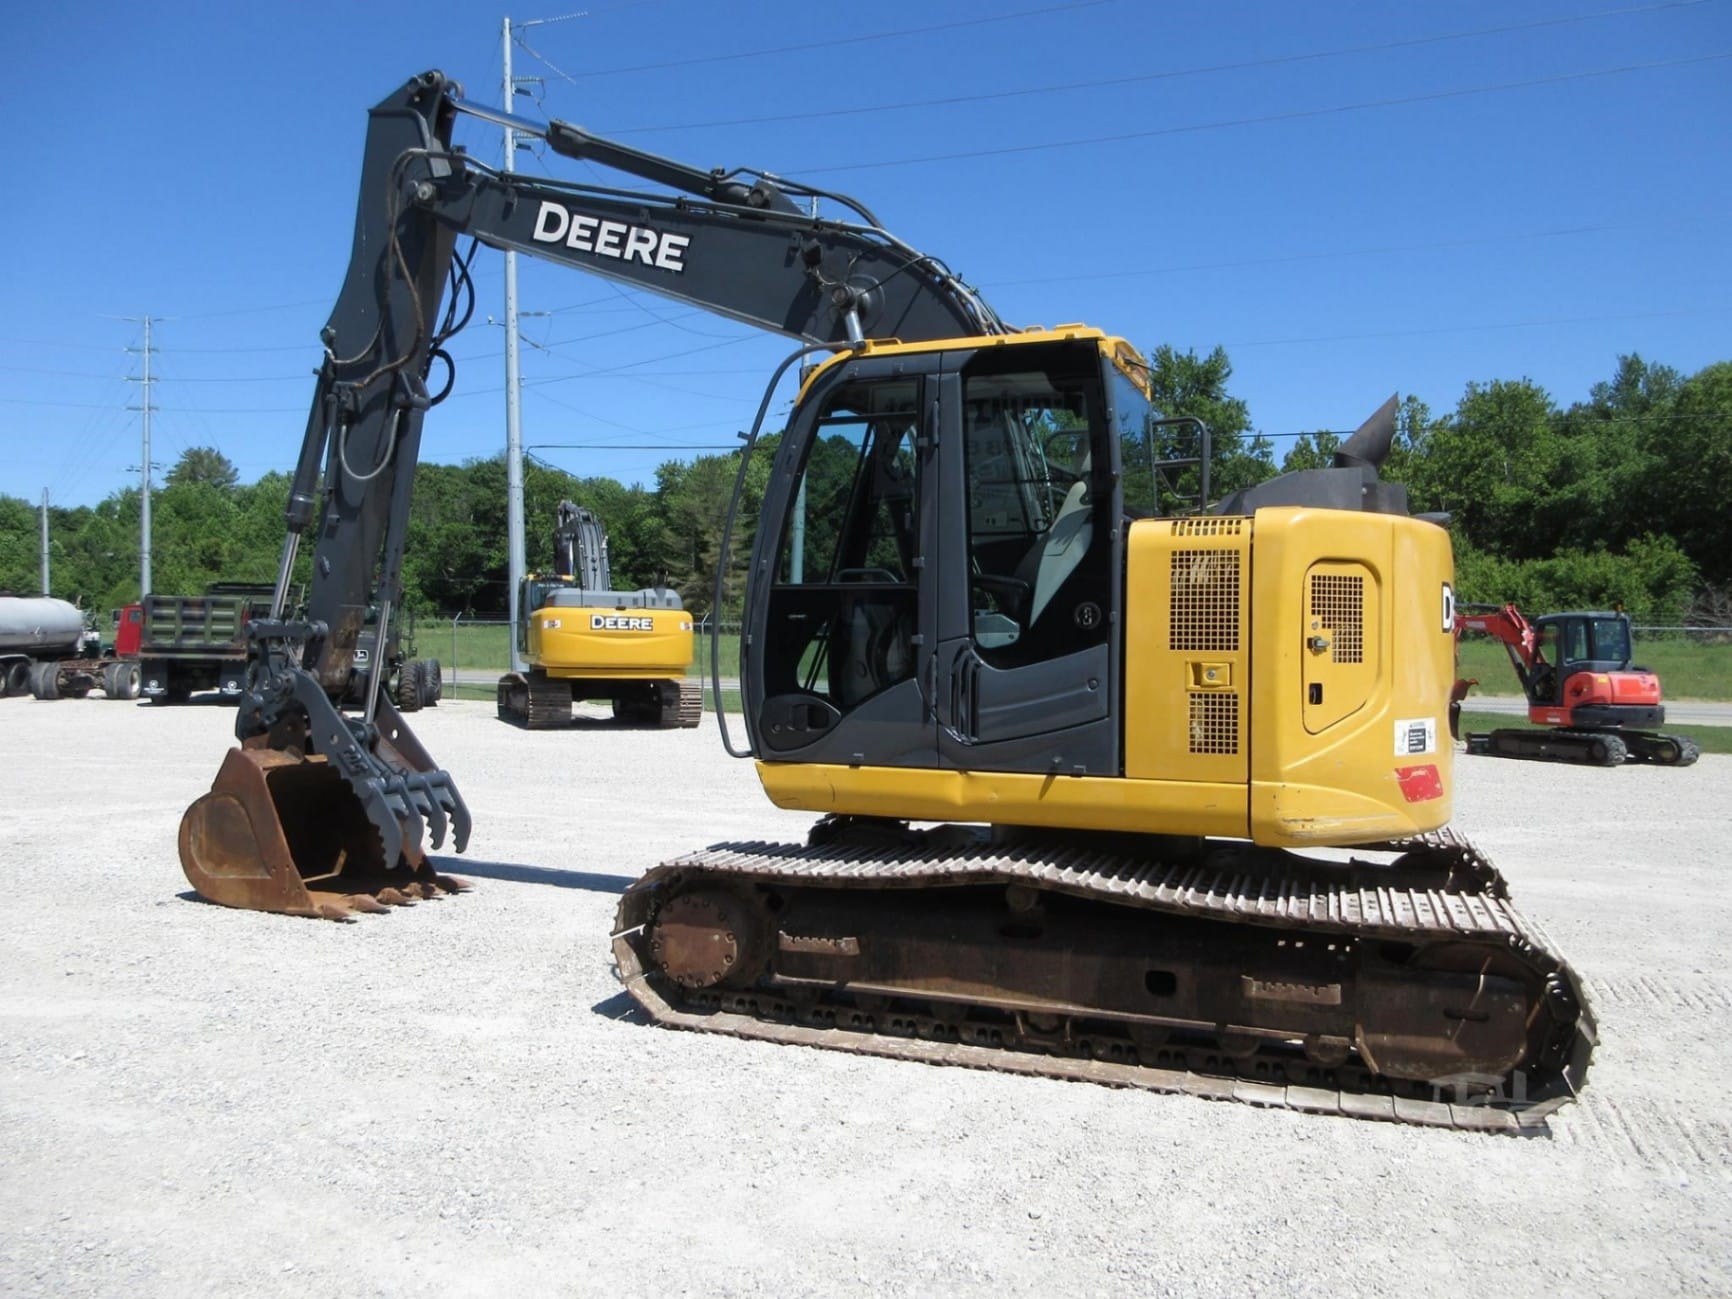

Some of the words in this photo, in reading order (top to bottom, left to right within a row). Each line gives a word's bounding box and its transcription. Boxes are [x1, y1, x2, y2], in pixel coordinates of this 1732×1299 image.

[533, 201, 690, 271] DEERE
[591, 615, 652, 630] DEERE
[1443, 586, 1455, 629] D
